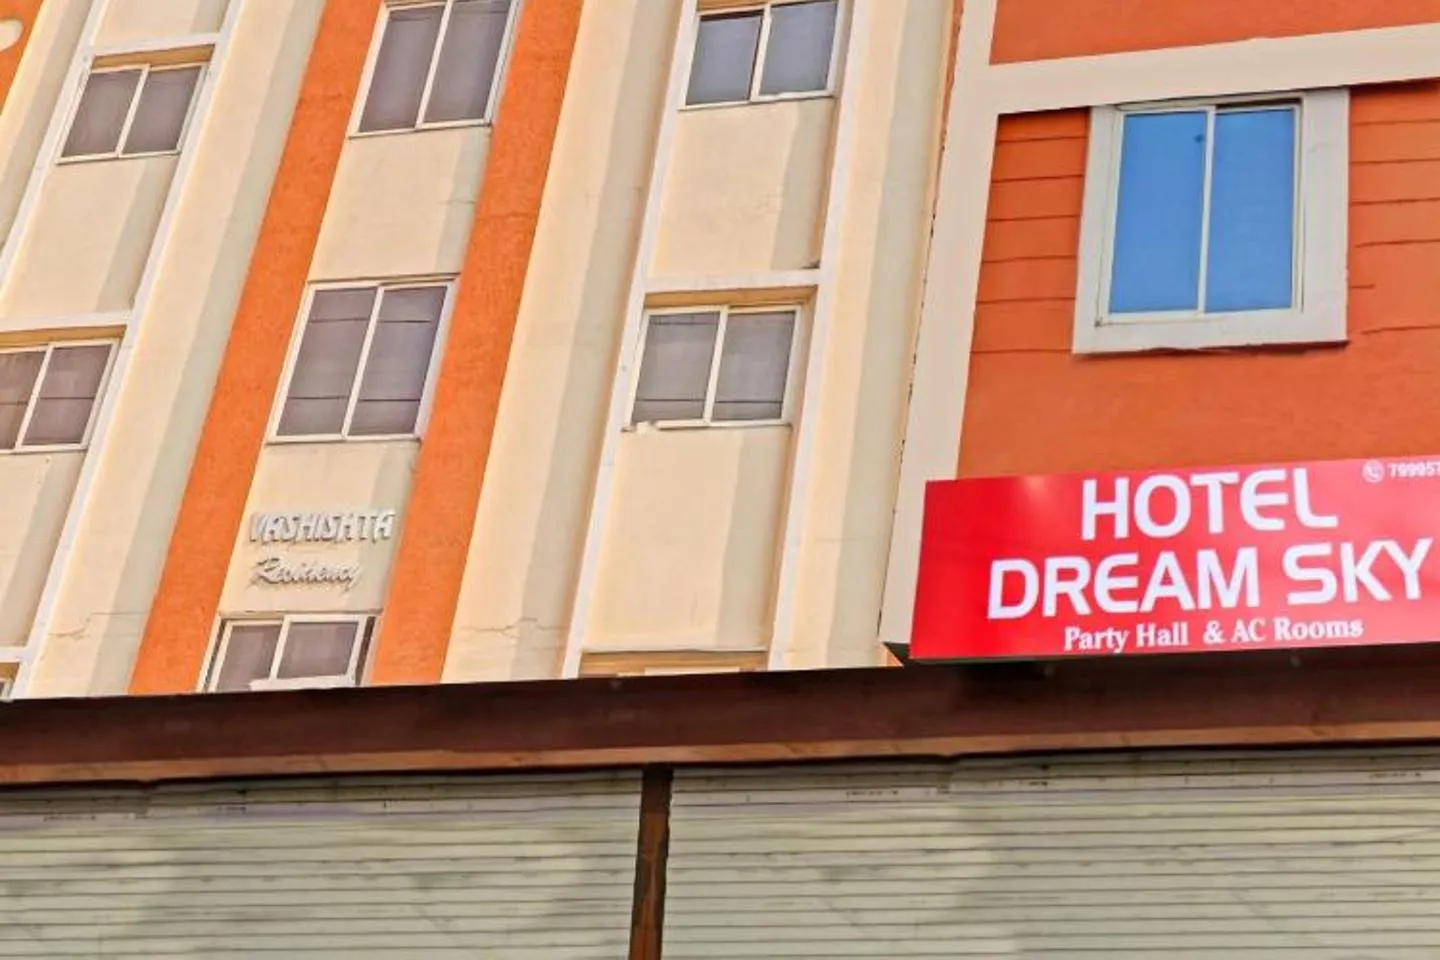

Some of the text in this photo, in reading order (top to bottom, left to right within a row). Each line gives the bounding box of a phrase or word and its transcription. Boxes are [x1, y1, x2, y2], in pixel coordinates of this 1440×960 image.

[1081, 468, 1338, 540] HOTEL
[987, 538, 1433, 620] DREAM SKY
[1064, 617, 1364, 654] Party Hall & AC Rooms
